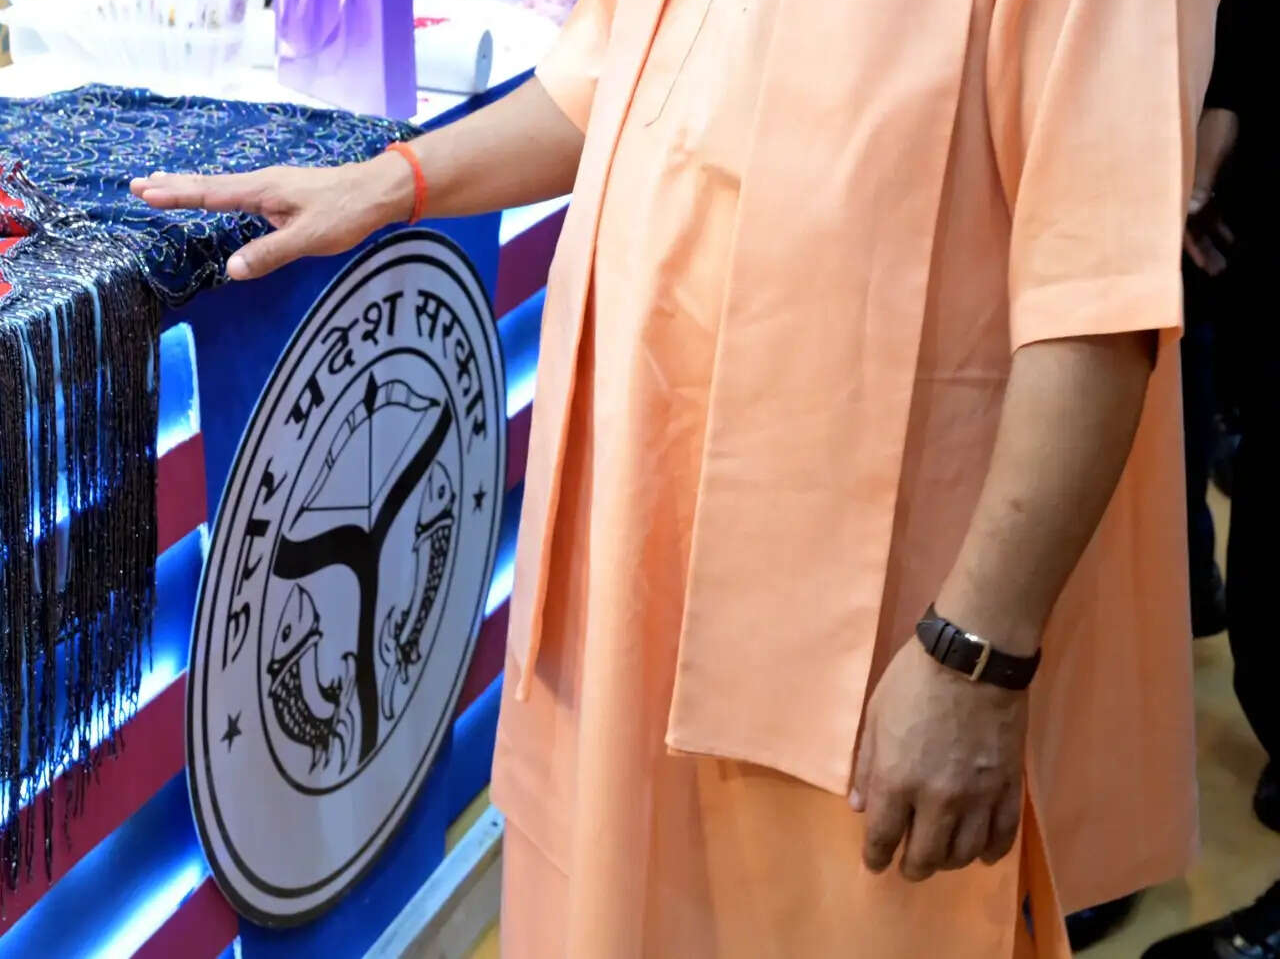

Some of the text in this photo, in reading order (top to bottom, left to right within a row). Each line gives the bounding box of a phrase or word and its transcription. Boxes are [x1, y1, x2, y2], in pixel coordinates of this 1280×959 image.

[222, 288, 488, 671] उत्तर प्रदेश सरकार
